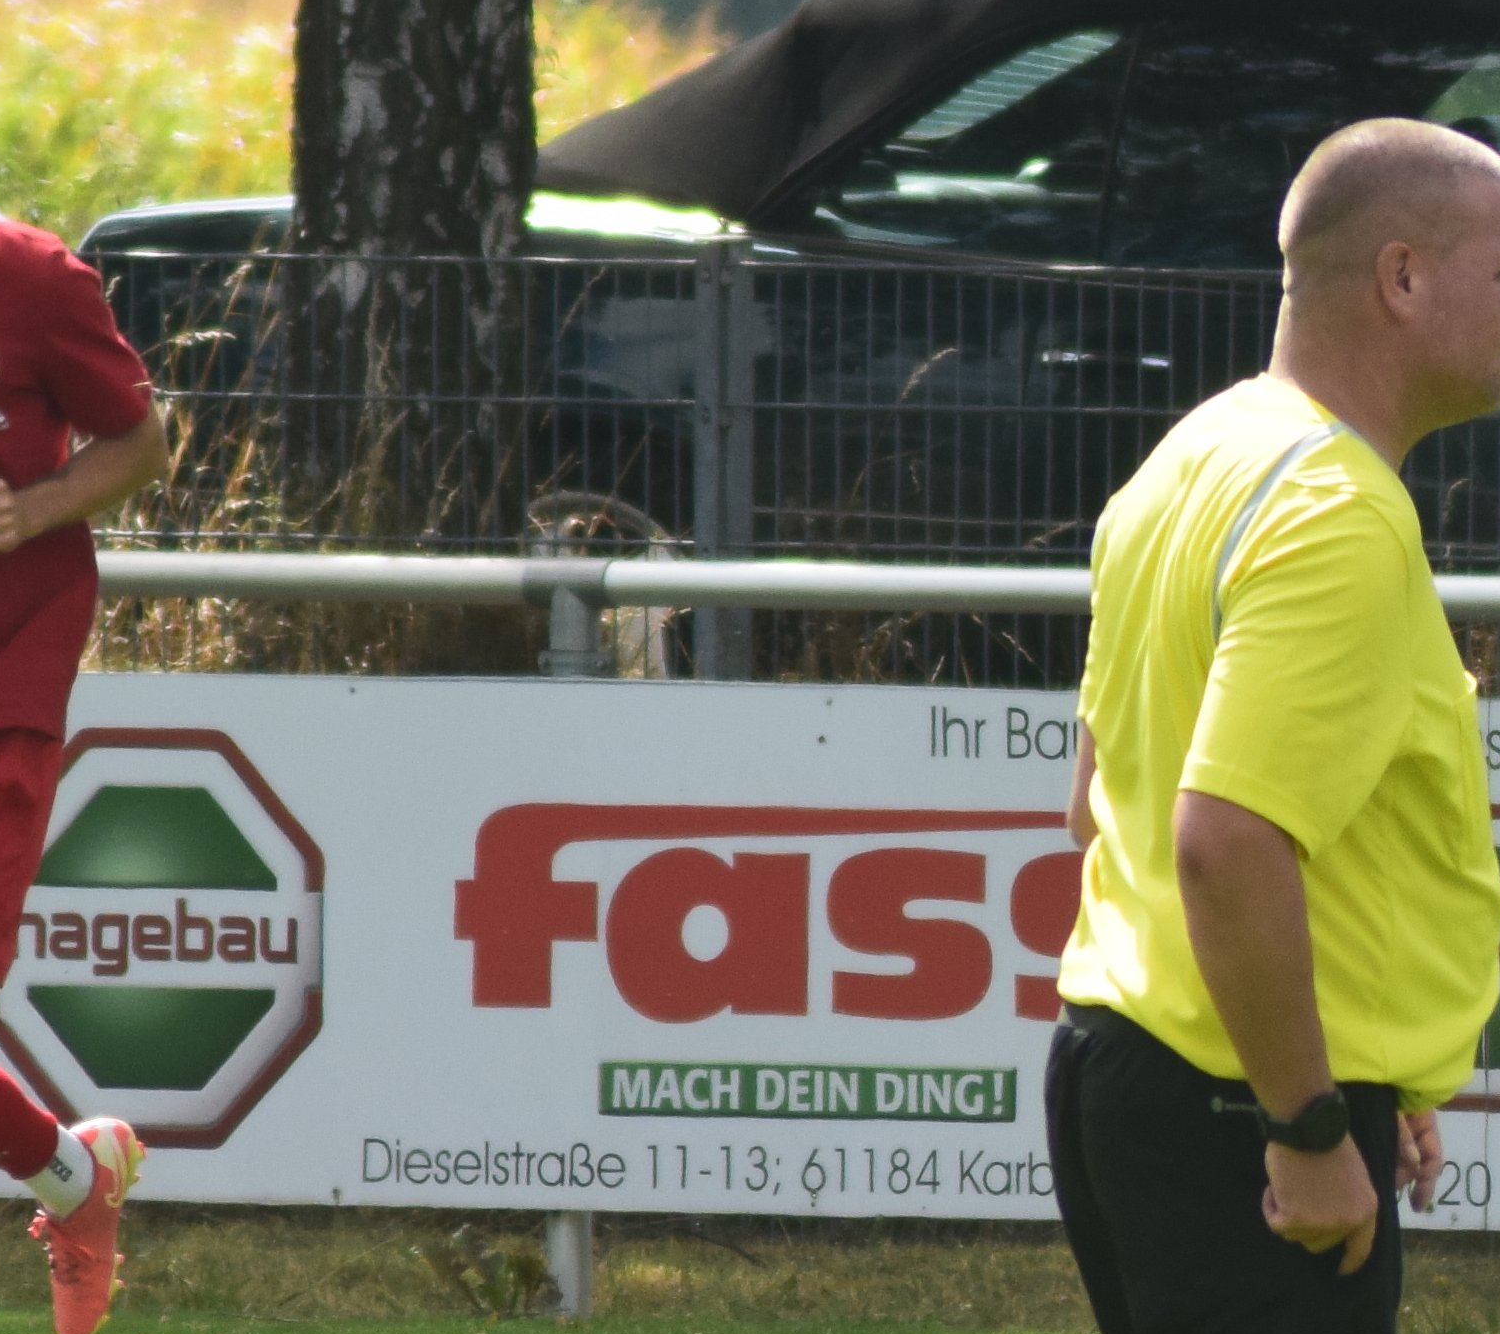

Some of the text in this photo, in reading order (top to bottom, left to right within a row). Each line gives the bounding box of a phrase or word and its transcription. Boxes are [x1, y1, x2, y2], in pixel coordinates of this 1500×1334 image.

[930, 705, 987, 759] Ihr
[1006, 706, 1078, 761] Ba
[611, 1068, 1005, 1116] MACH DEIN DING!
[362, 1137, 626, 1189] Dieselstraße
[647, 1145, 781, 1196] 11-13;
[801, 1148, 940, 1194] 61184
